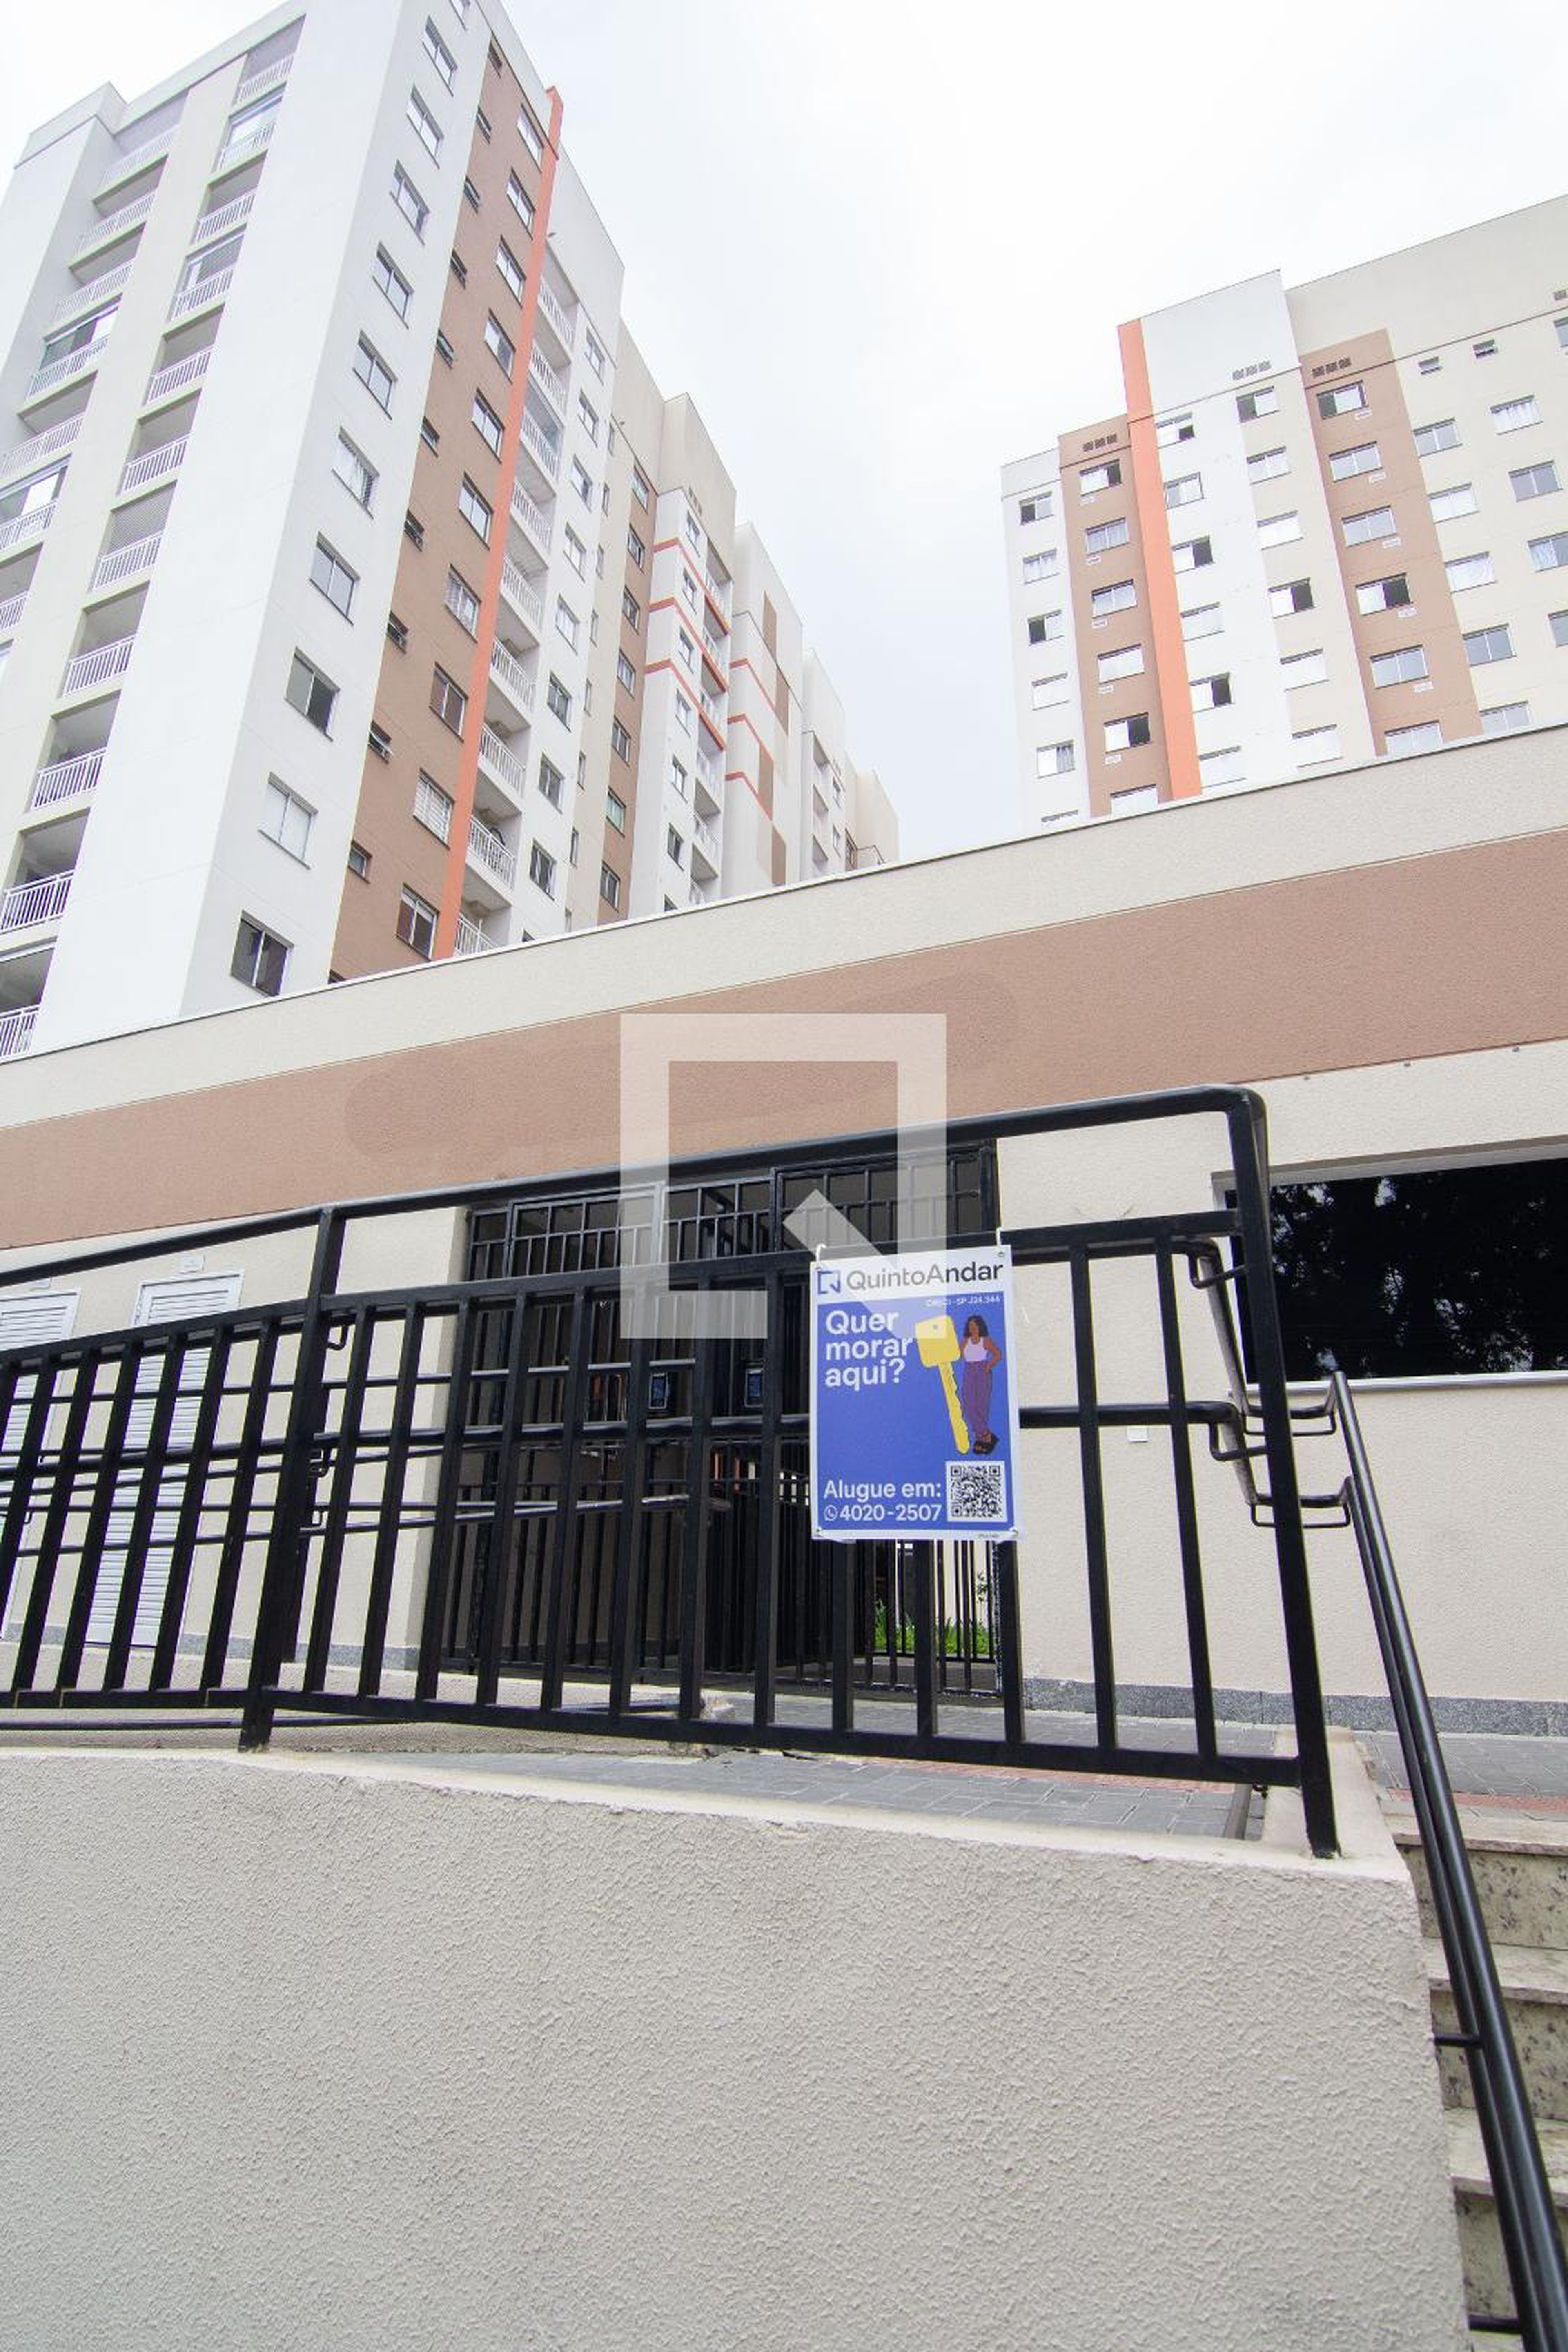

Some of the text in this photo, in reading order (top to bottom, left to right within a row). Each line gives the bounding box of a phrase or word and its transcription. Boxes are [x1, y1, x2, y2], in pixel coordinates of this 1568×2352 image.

[846, 1262, 1003, 1291] QuintoAndar
[826, 1310, 898, 1334] Quer
[826, 1338, 913, 1360] morar
[825, 1358, 905, 1391] aqui?
[824, 1480, 941, 1503] Alugue em:
[840, 1504, 942, 1521] 4020-2507
